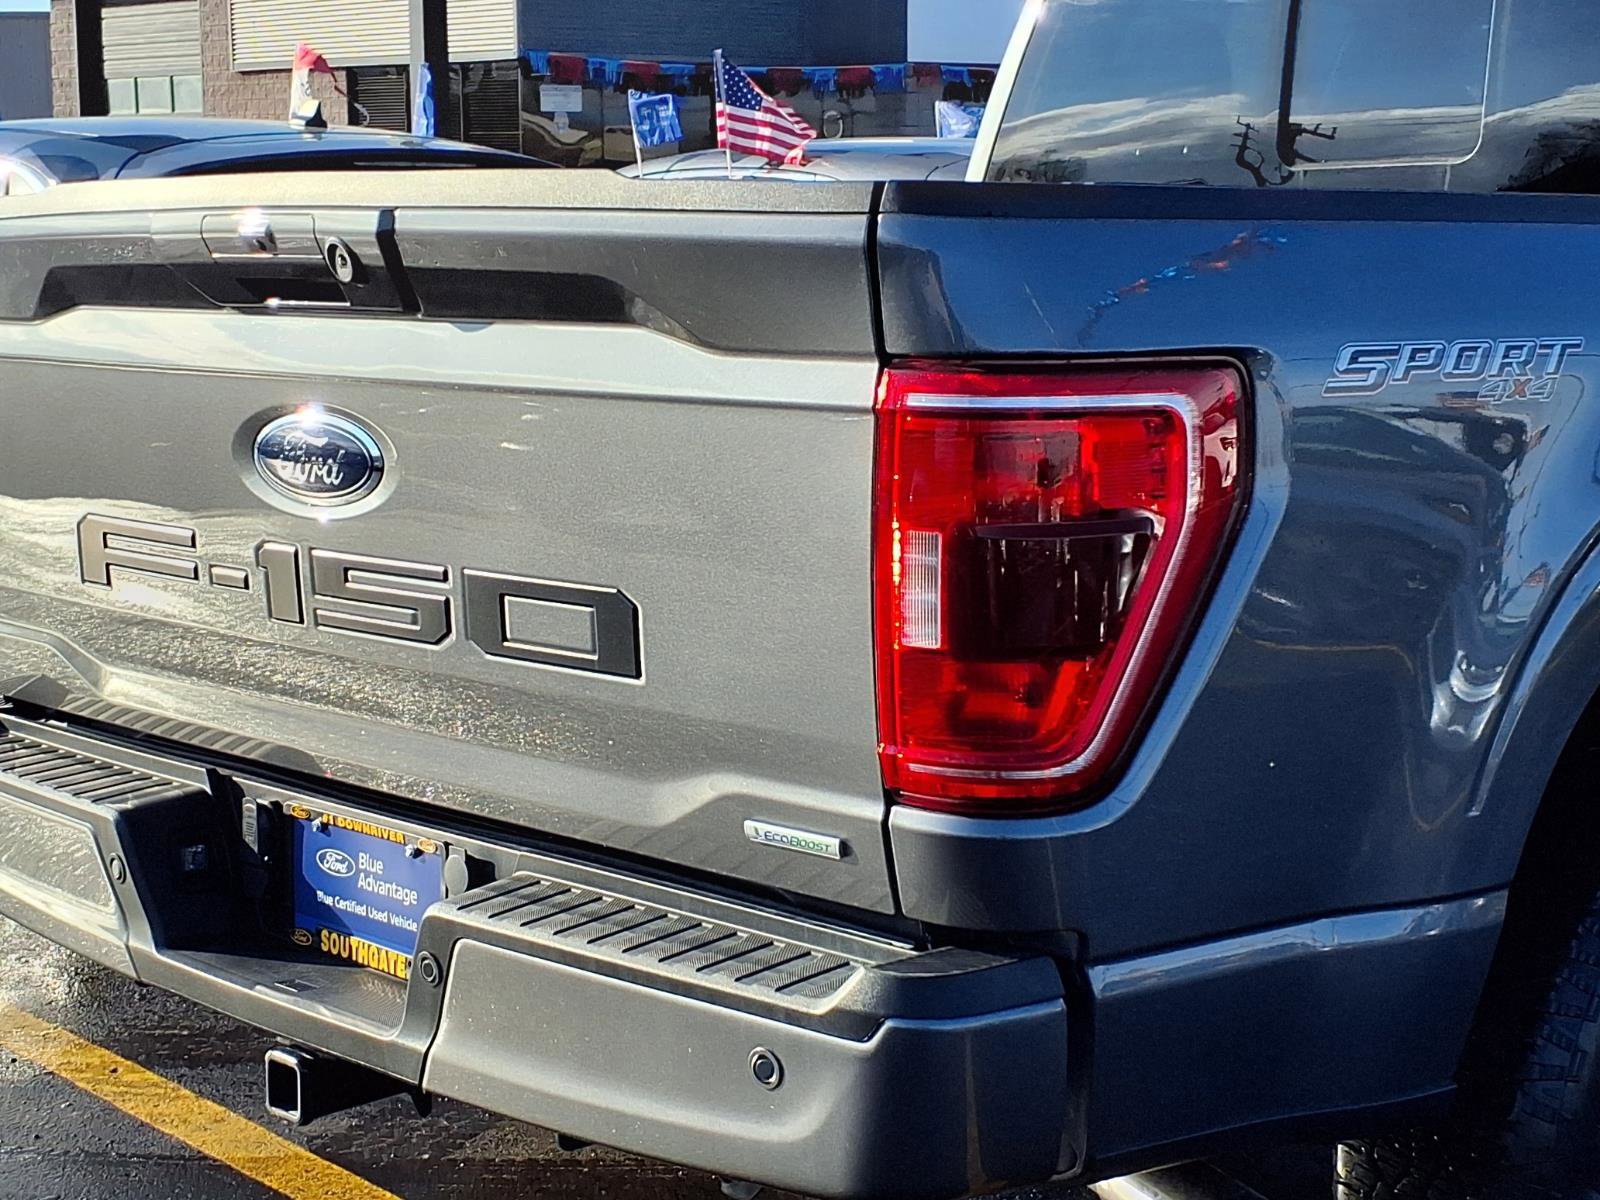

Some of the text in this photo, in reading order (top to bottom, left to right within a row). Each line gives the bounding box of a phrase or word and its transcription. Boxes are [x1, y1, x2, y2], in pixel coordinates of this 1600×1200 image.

[1321, 337, 1584, 398] SPORT
[78, 513, 646, 685] F-150
[337, 816, 405, 844] DOWNRIVER
[321, 852, 349, 875] Ford
[358, 852, 384, 875] Blue
[357, 874, 418, 906] Advantage
[334, 896, 367, 917] Certified
[367, 905, 388, 923] Used
[320, 928, 407, 979] SOUTHGATE
